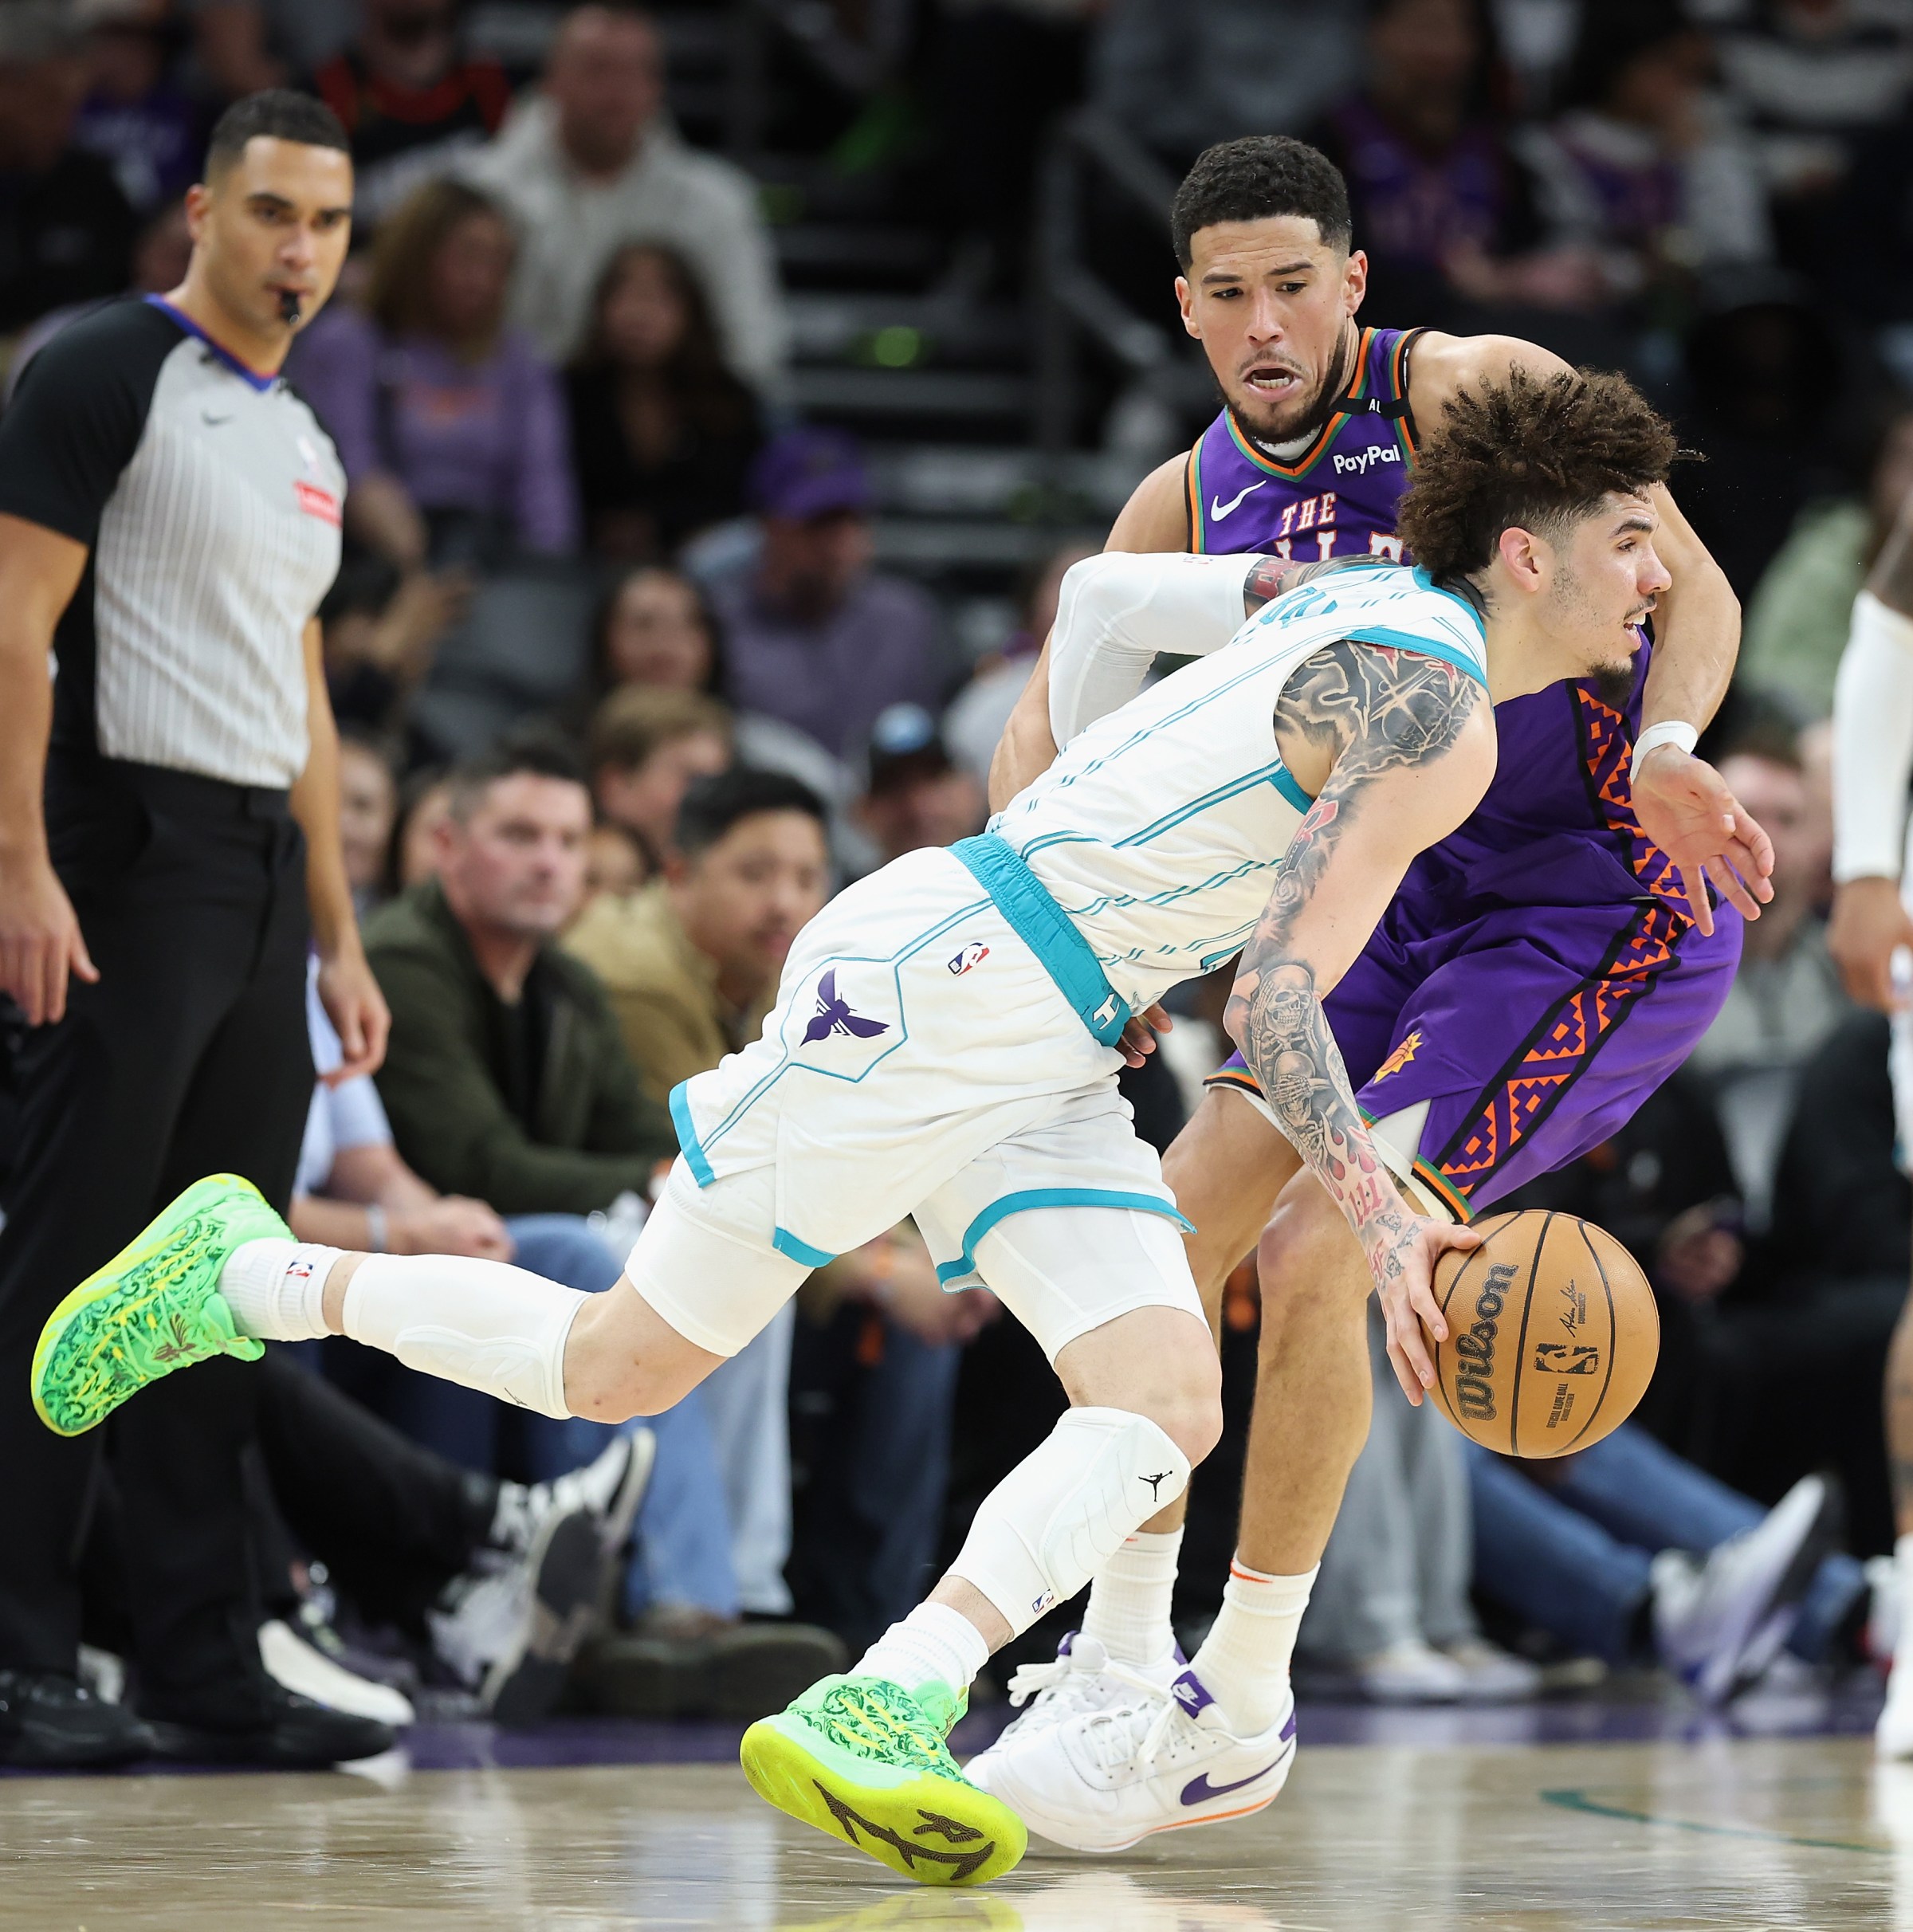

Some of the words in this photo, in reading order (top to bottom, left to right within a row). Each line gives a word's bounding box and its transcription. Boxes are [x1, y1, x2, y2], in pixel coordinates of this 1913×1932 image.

[1368, 398, 1381, 414] AL
[1333, 444, 1401, 475] PayPal
[1279, 491, 1337, 536] THE
[1455, 1262, 1519, 1420] Wilson
